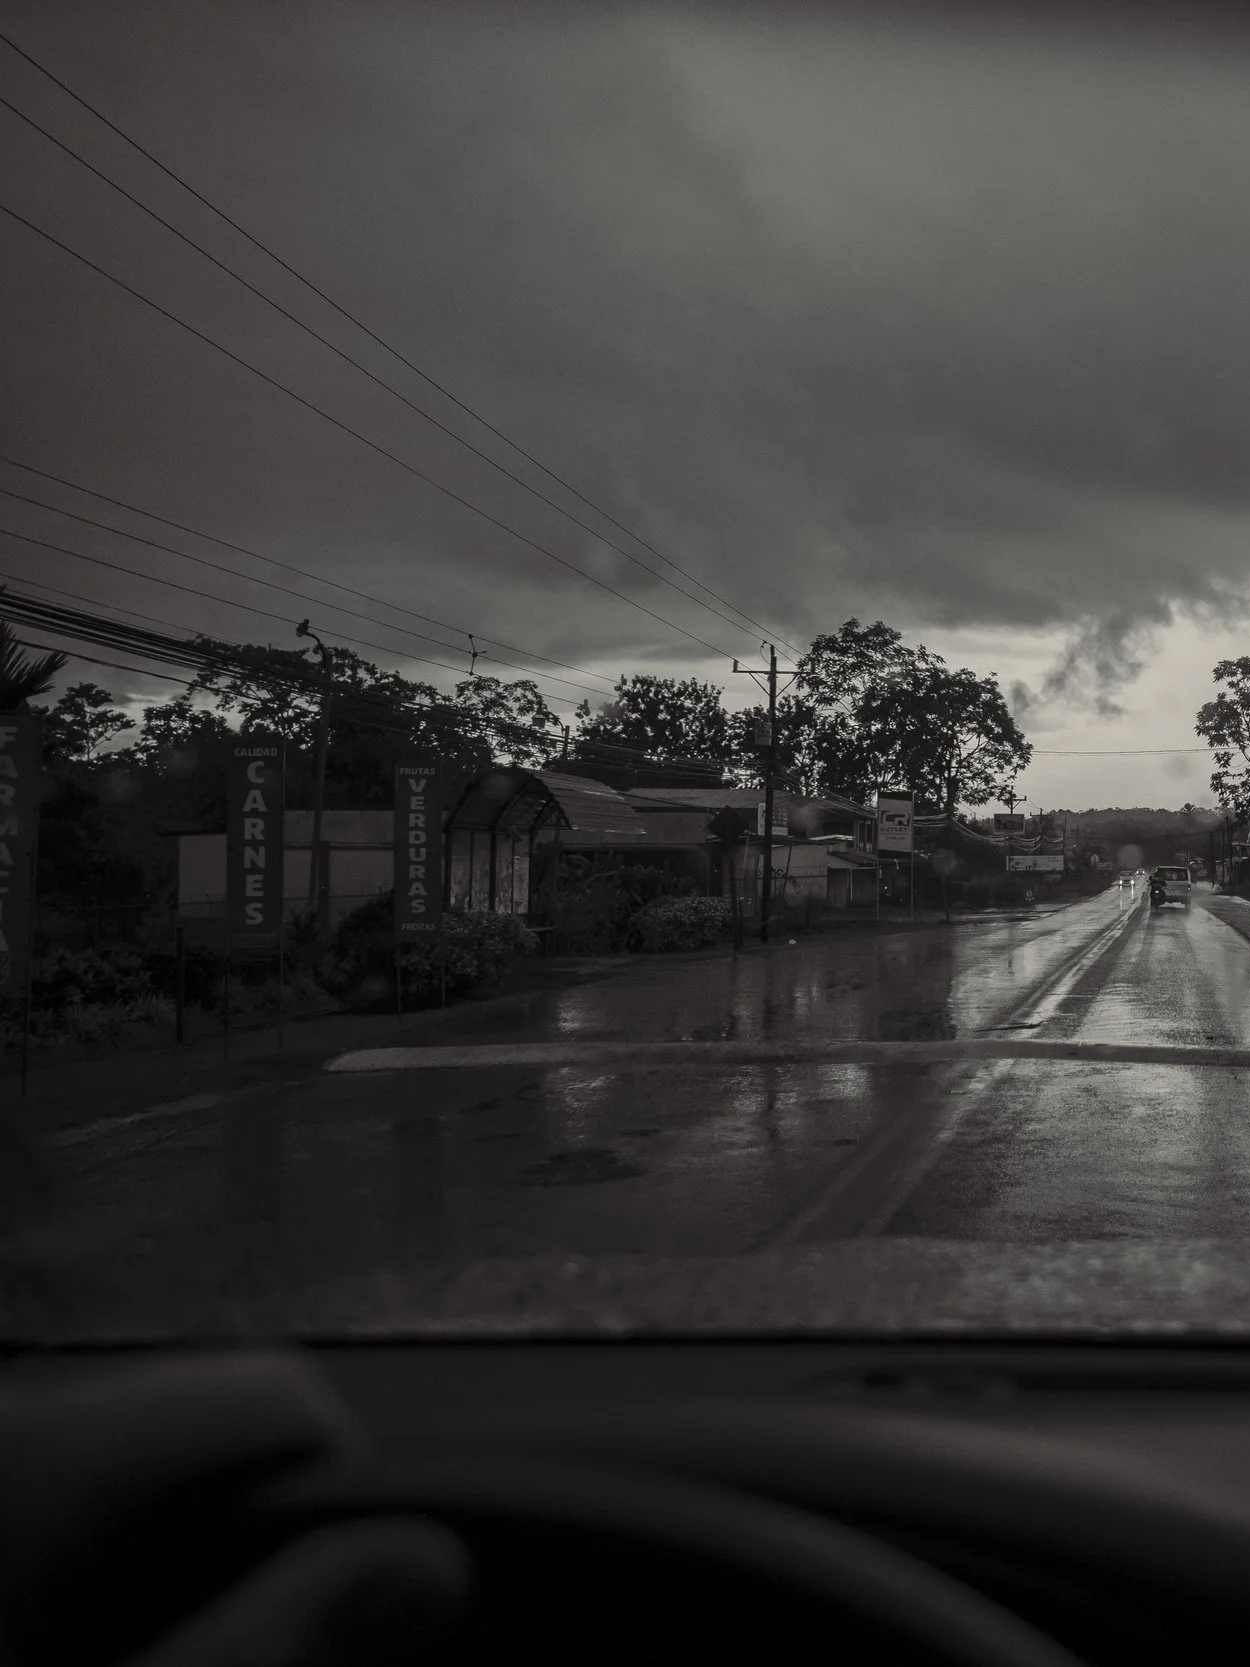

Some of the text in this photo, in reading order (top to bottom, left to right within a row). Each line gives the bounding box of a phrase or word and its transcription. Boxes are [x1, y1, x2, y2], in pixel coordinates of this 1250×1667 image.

[234, 747, 278, 757] CALIDAD
[399, 767, 436, 775] FRUTAS
[242, 760, 268, 925] CARNES
[408, 778, 428, 913] VERDURAS
[401, 923, 436, 931] FRESCAS
